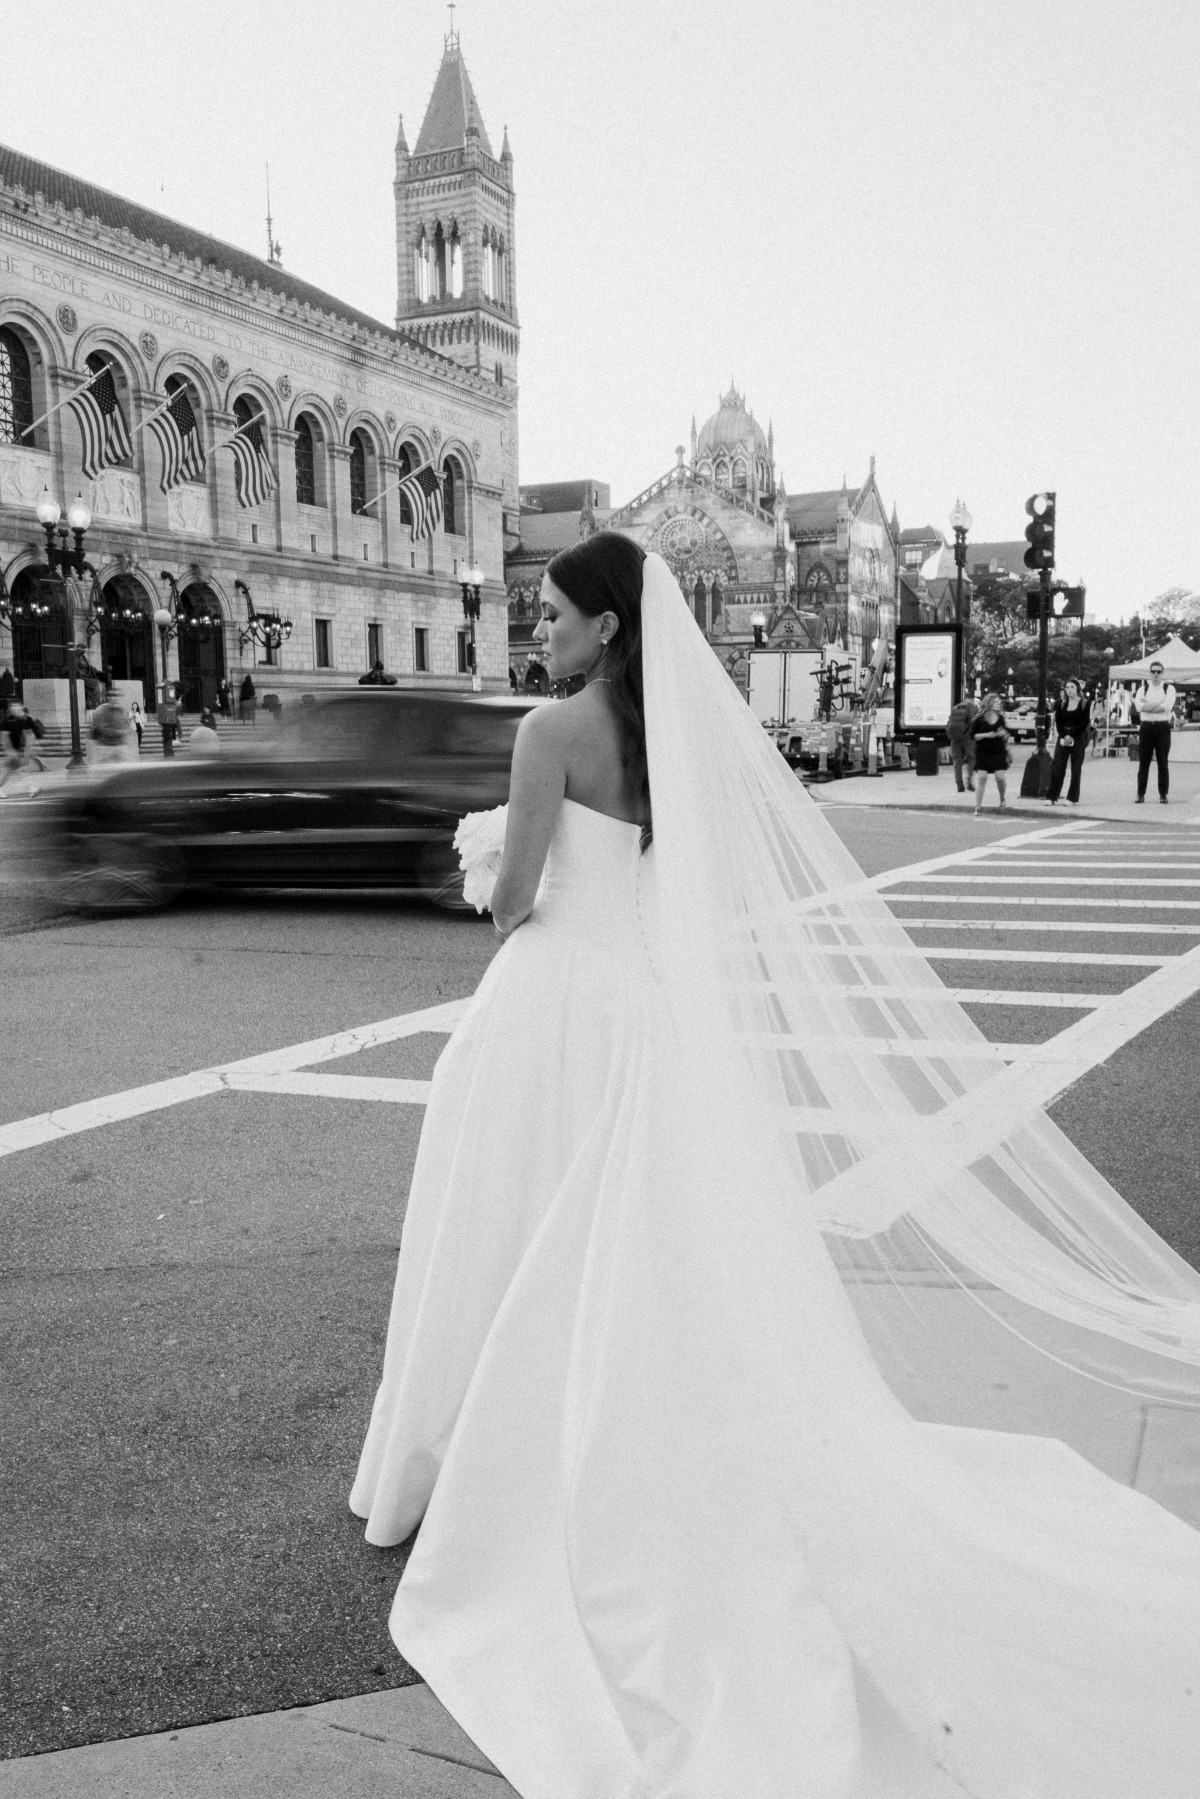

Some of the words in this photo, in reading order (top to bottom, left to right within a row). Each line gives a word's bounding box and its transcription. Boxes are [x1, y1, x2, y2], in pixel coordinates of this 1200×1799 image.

[33, 265, 90, 299] PEOPLE
[102, 291, 132, 313] AND
[143, 303, 217, 341] DEDICATED
[226, 332, 243, 350] TO
[249, 341, 271, 361] THE
[356, 379, 368, 393] OF
